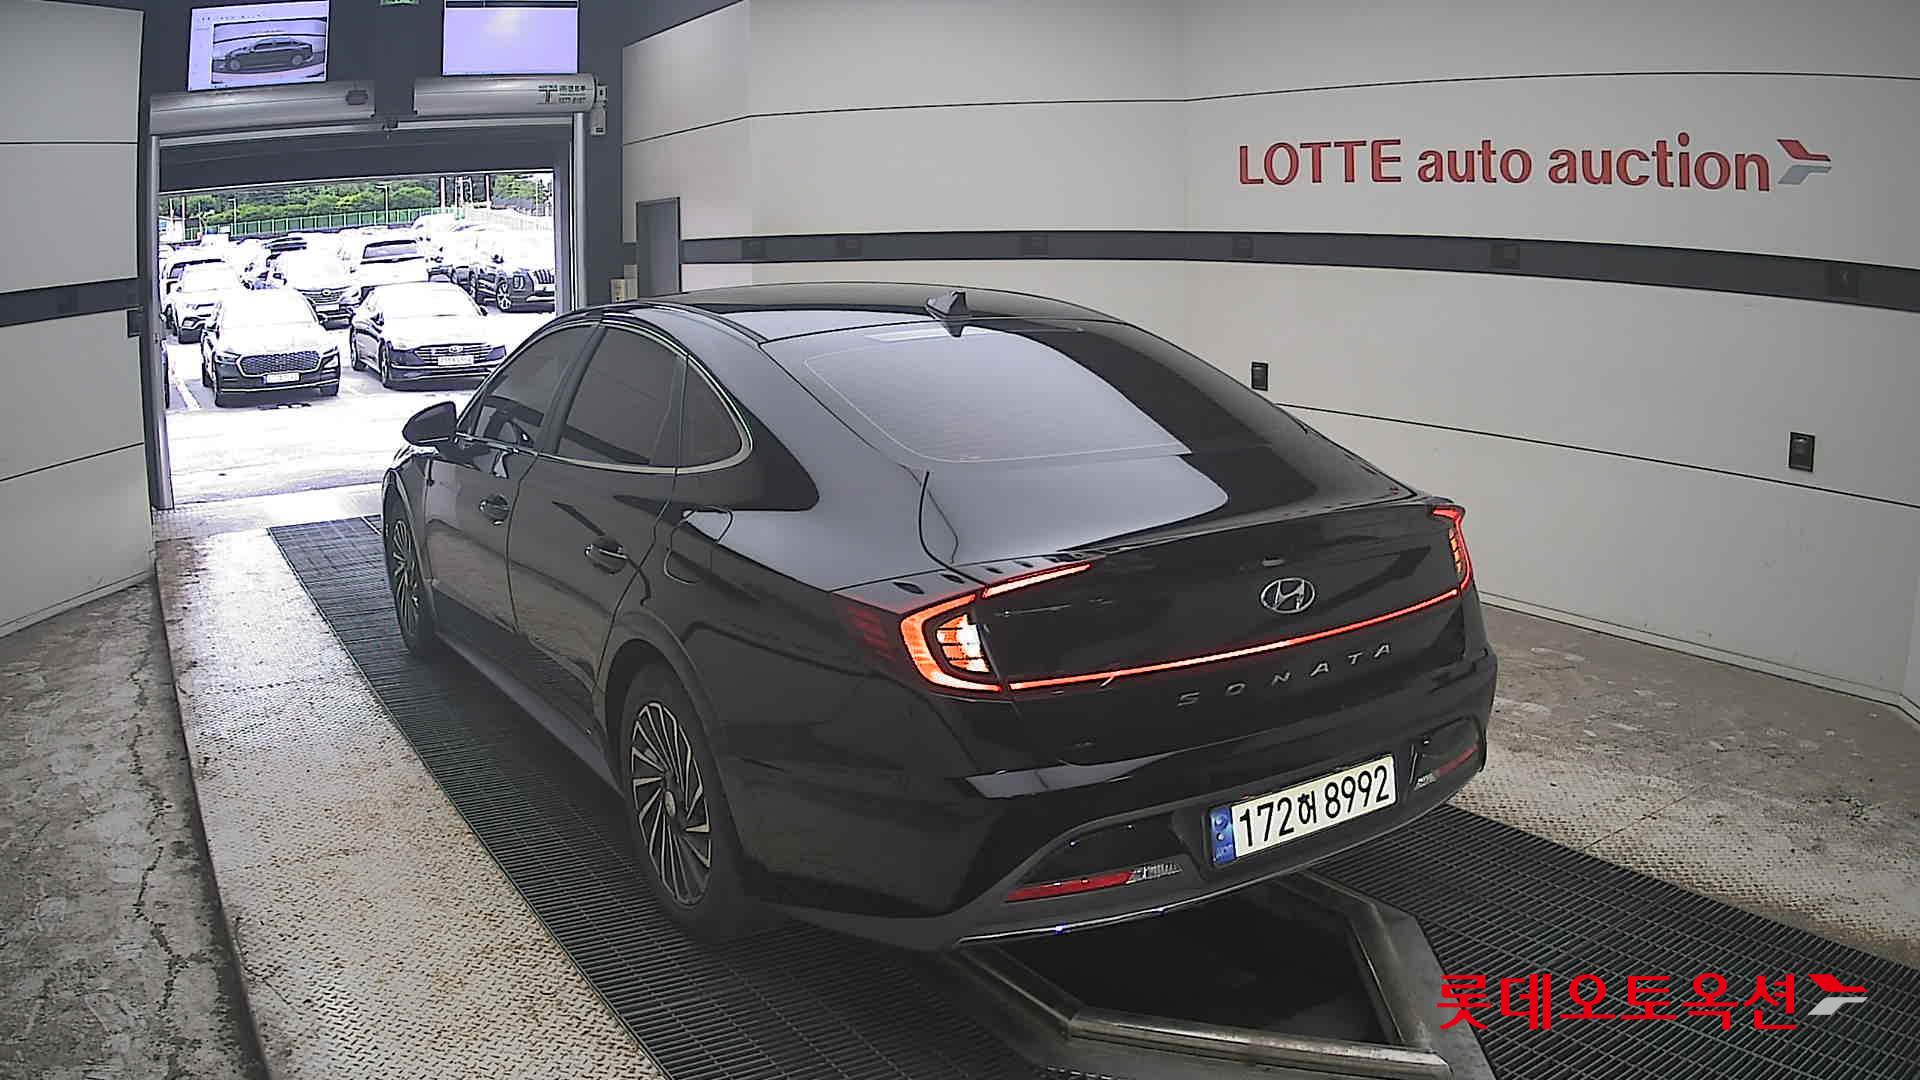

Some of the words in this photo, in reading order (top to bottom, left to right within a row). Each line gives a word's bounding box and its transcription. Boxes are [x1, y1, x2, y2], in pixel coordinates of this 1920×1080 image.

[1240, 140, 1401, 185] LOTTE
[1418, 140, 1532, 184] auto
[1548, 133, 1770, 191] auction
[1177, 643, 1391, 707] SONATA
